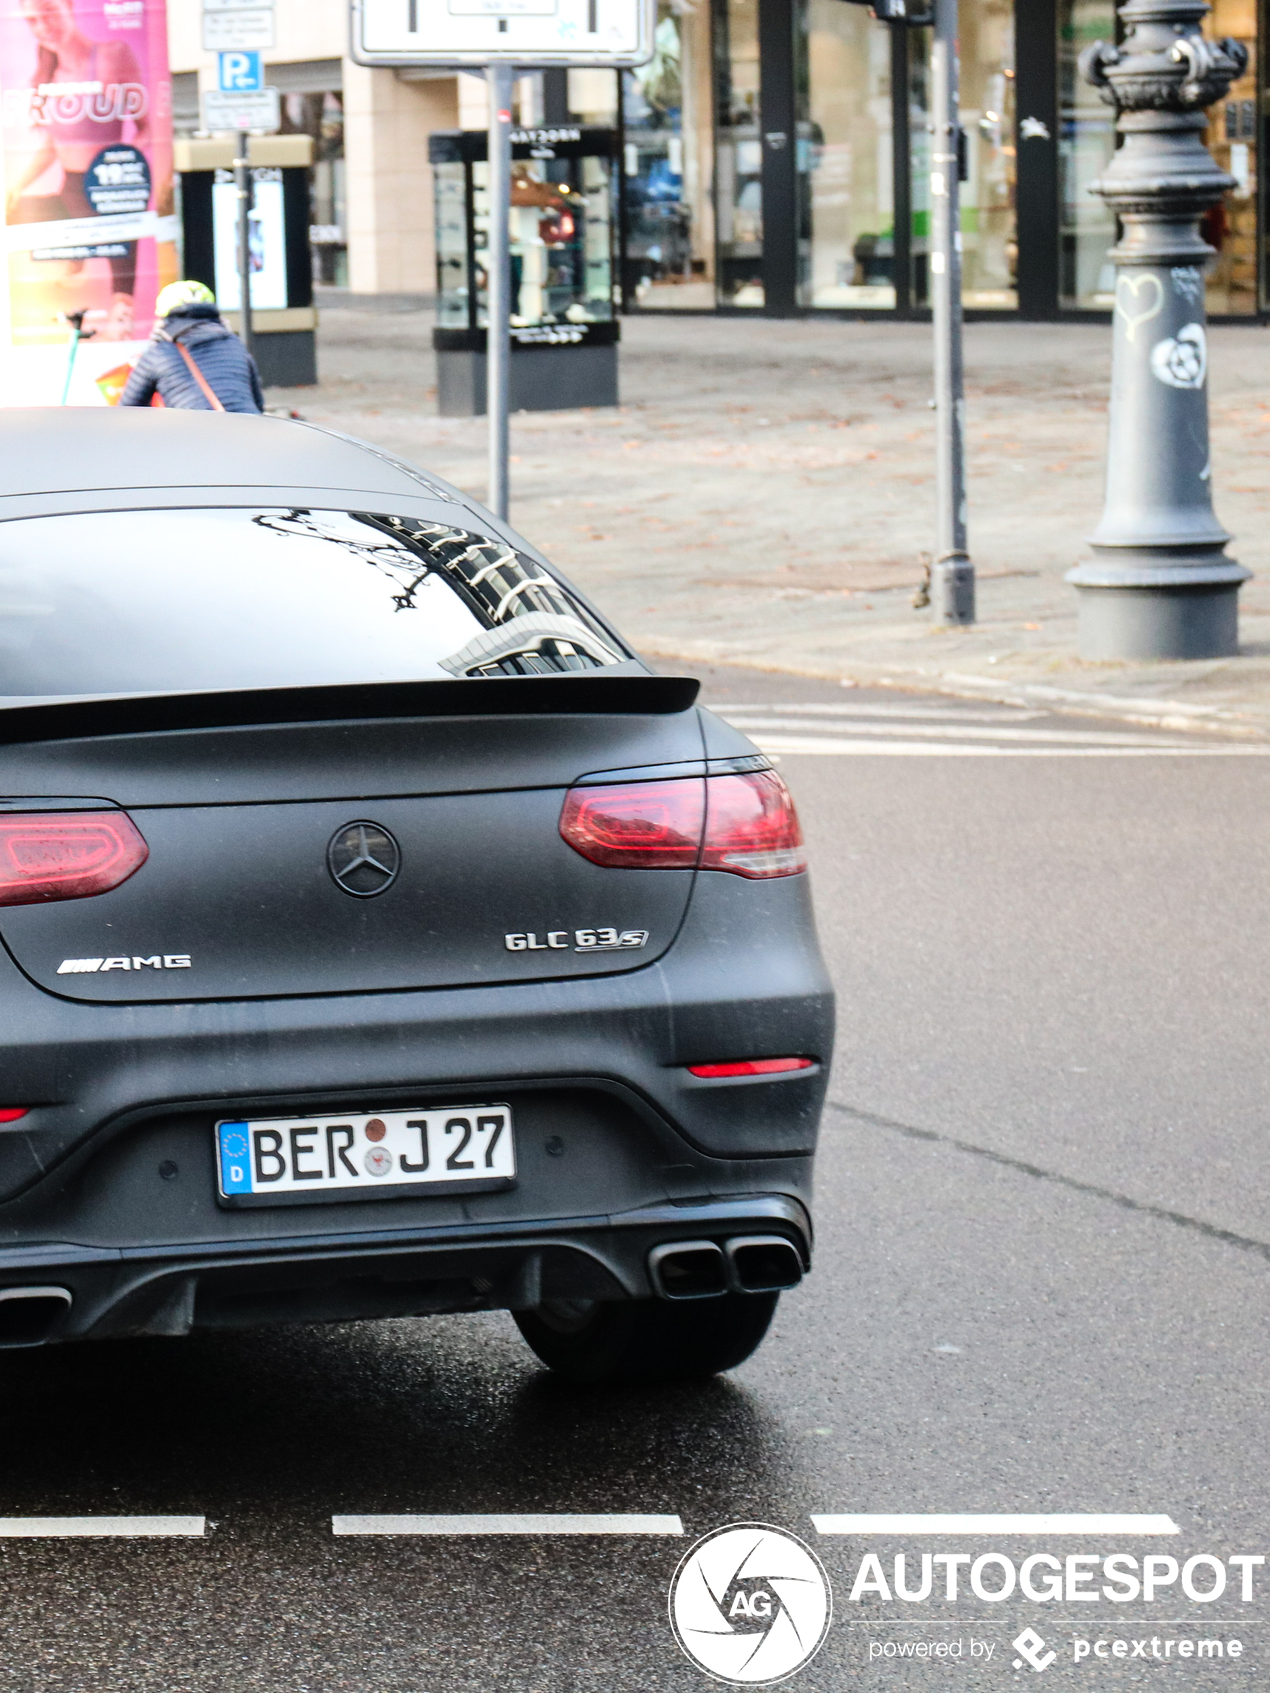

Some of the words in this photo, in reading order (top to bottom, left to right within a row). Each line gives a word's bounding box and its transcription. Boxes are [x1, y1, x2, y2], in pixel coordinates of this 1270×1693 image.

[222, 53, 251, 88] P
[505, 931, 569, 951] GLC
[100, 954, 192, 972] AMG
[253, 1126, 359, 1183] BER
[400, 1120, 427, 1173] J
[445, 1115, 505, 1171] 27
[230, 1165, 244, 1183] D
